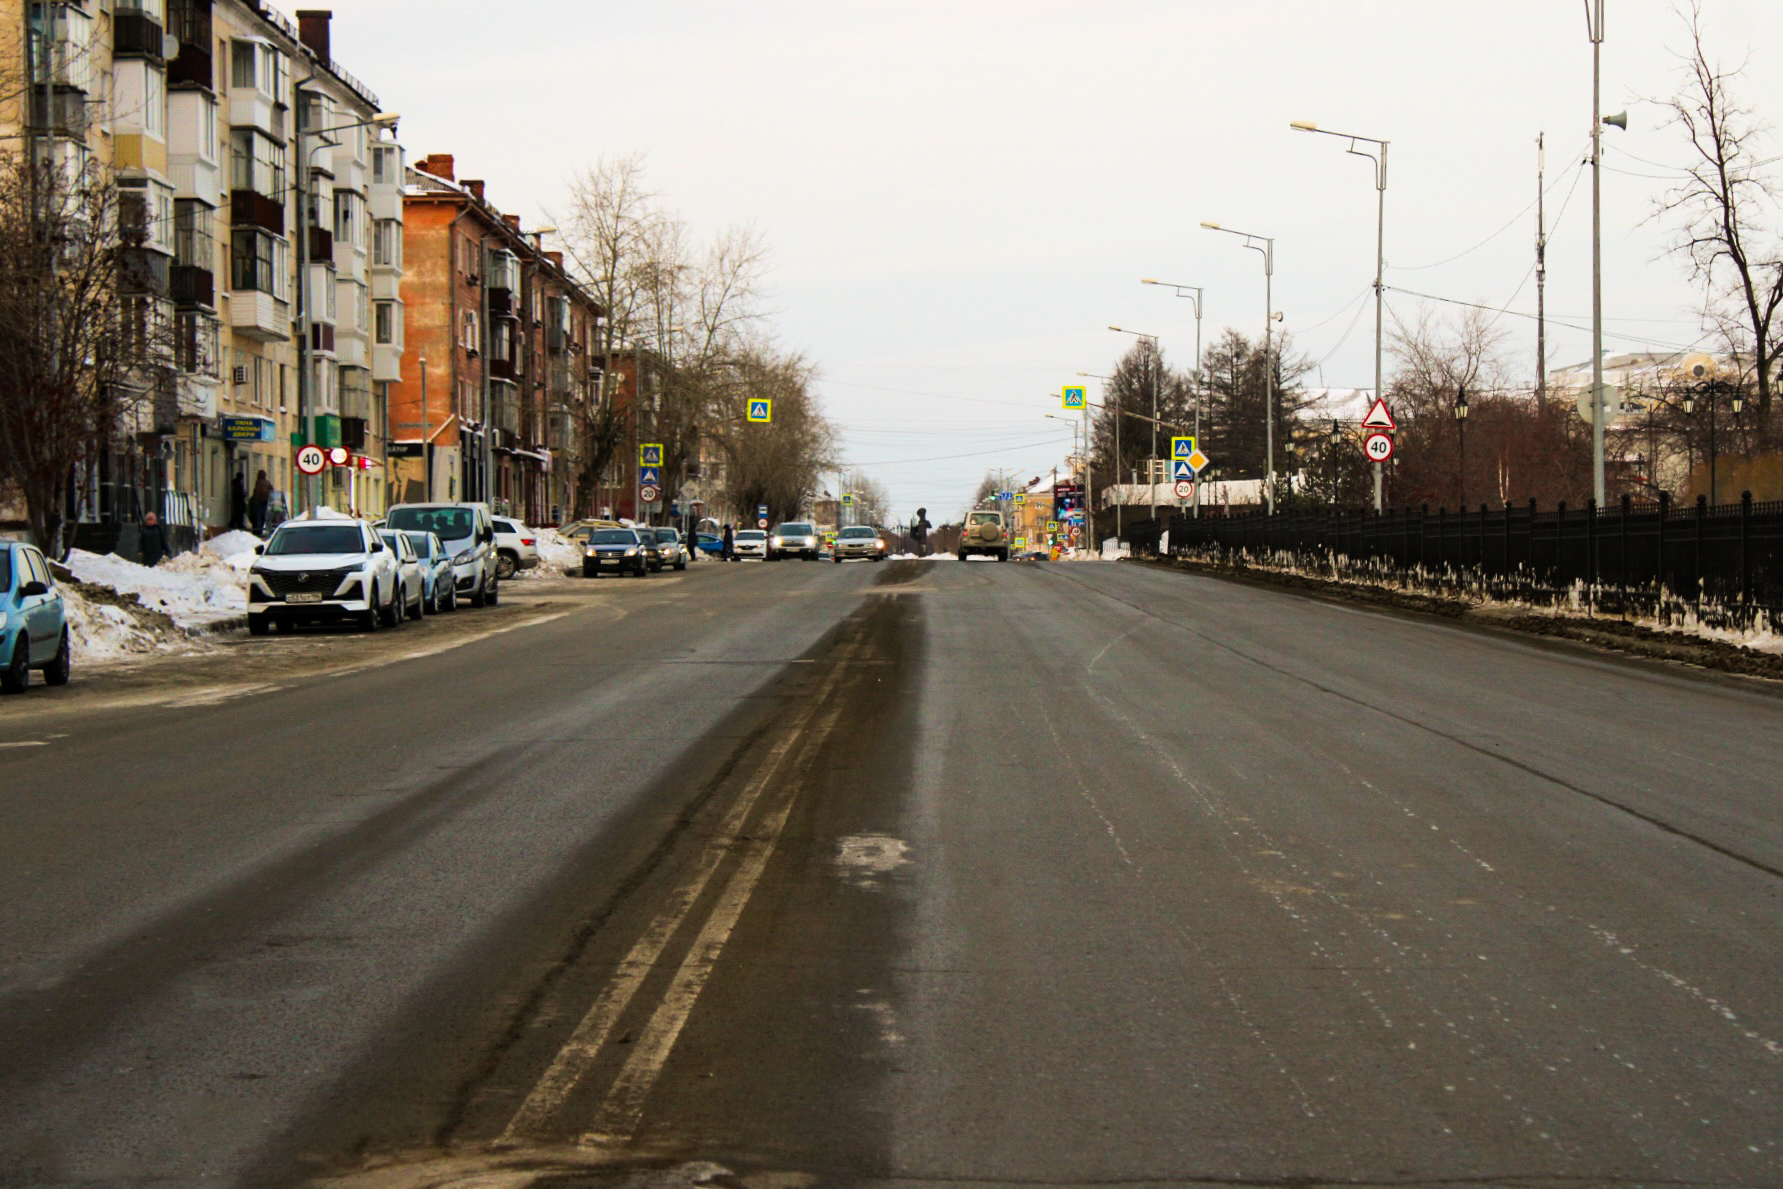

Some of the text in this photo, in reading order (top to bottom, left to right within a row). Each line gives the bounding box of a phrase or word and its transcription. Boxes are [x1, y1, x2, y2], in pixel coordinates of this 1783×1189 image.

[1371, 441, 1387, 453] 40
[303, 453, 320, 465] 40
[1179, 485, 1189, 493] 20
